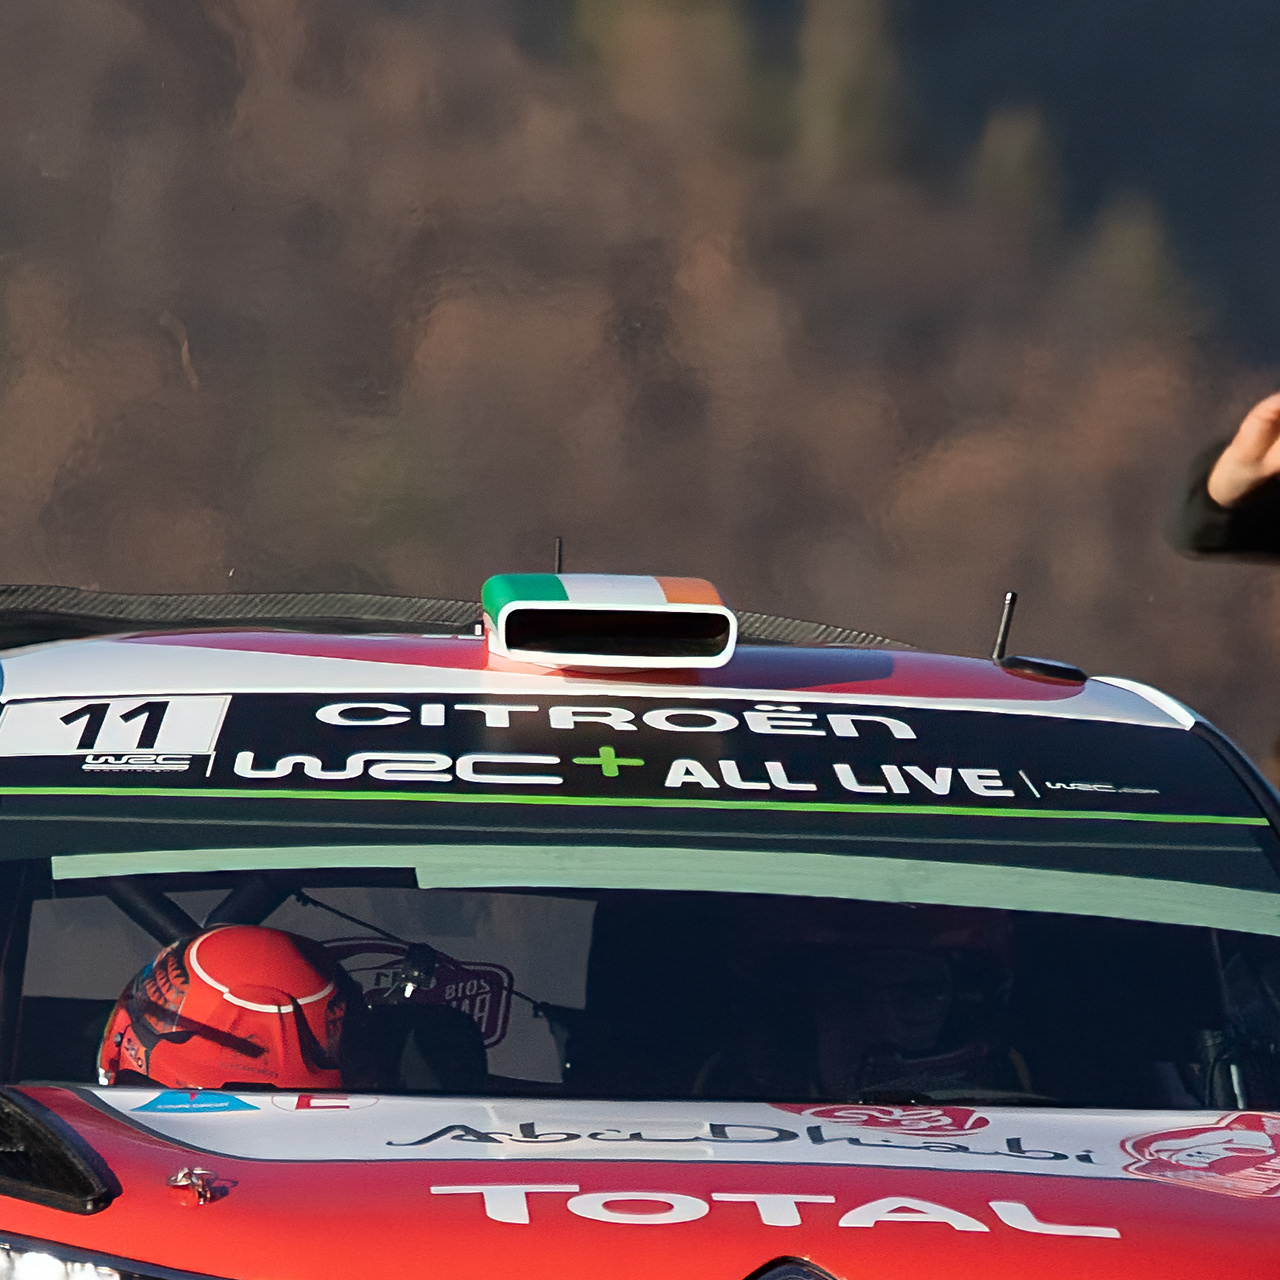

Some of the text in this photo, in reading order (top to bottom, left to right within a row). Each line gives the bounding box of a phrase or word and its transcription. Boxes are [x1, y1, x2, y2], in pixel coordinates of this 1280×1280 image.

[59, 701, 170, 750] 11
[664, 758, 818, 791] ALL
[832, 763, 1016, 797] LIVE
[430, 1183, 1121, 1239] TOTAL
